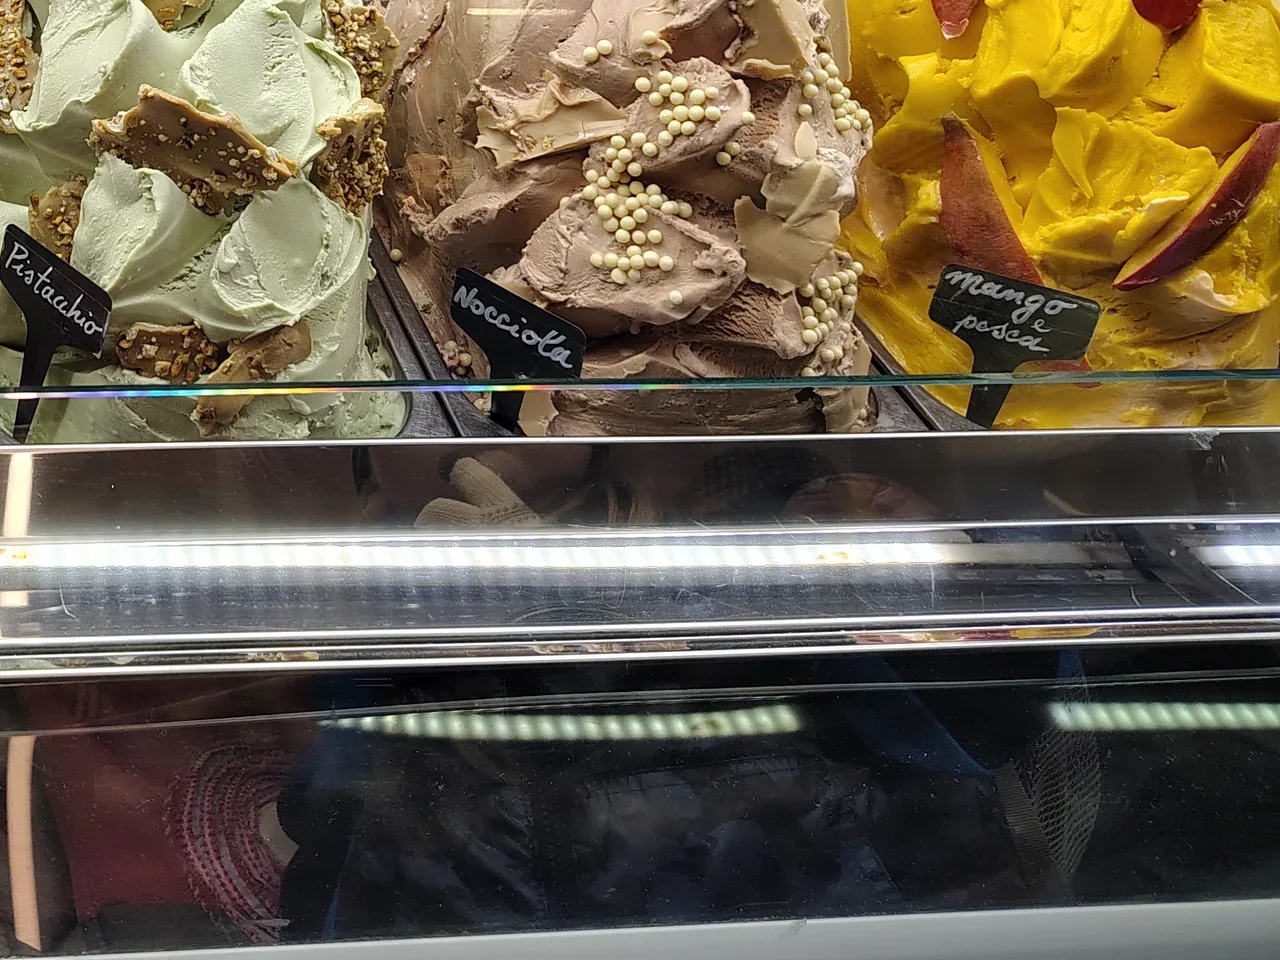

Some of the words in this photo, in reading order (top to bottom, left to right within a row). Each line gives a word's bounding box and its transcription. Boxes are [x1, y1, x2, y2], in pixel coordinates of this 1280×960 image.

[5, 241, 103, 335] Pistacchio
[453, 285, 573, 368] Nocciola
[952, 314, 1051, 352] pesca
[1031, 318, 1052, 333] e
